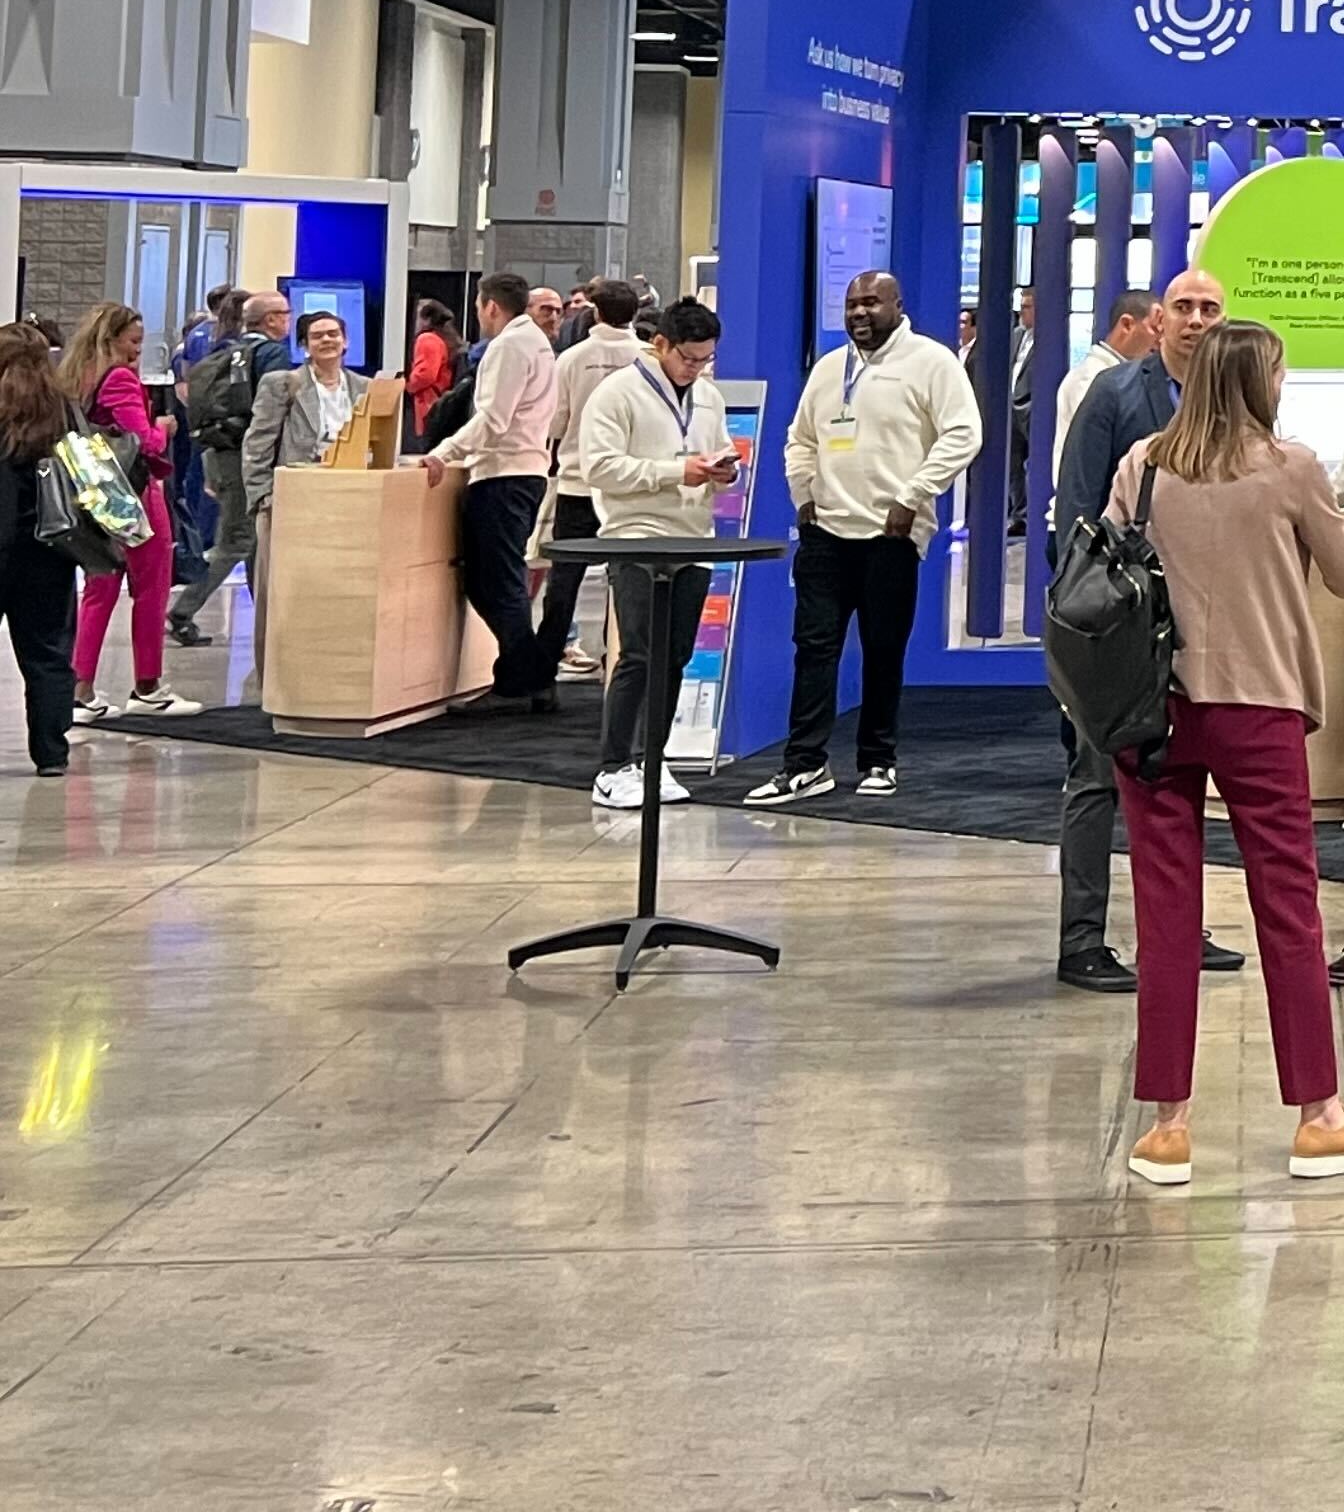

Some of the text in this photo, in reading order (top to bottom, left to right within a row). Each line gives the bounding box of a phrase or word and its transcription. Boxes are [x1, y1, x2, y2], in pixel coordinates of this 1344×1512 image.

[808, 37, 824, 66] Ask
[824, 49, 834, 69] us
[879, 61, 904, 94] privacy
[838, 89, 870, 120] business
[1281, 260, 1302, 269] one
[1305, 261, 1344, 271] person
[1252, 271, 1319, 286] [Transcend]
[1233, 287, 1281, 299] function
[1285, 290, 1297, 299] as
[1310, 288, 1331, 299] five
